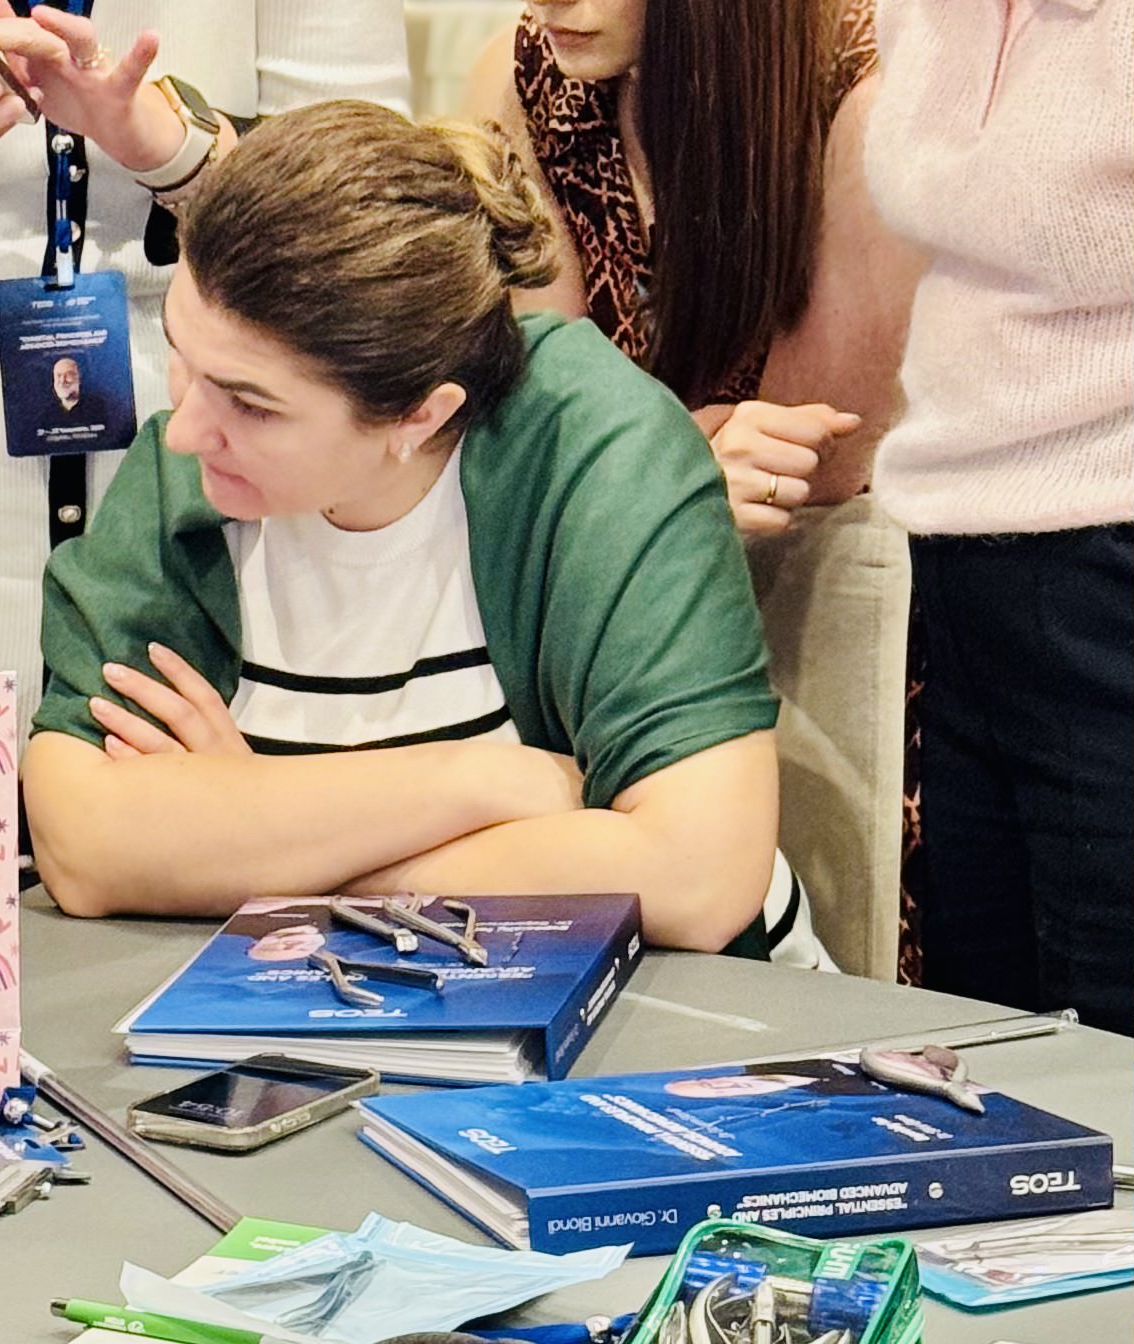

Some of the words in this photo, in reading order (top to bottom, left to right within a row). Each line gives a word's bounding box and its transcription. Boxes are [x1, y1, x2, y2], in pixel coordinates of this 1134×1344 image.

[308, 1008, 408, 1019] TEOS
[458, 1127, 518, 1155] TEOS
[839, 1181, 909, 1200] ADVANCED
[1010, 1170, 1082, 1197] TEOS
[594, 1210, 656, 1231] Giovanni
[657, 1208, 678, 1224] Dr.
[731, 1210, 761, 1224] AND
[762, 1203, 834, 1222] PRINCIPLES
[547, 1216, 592, 1235] Biondi
